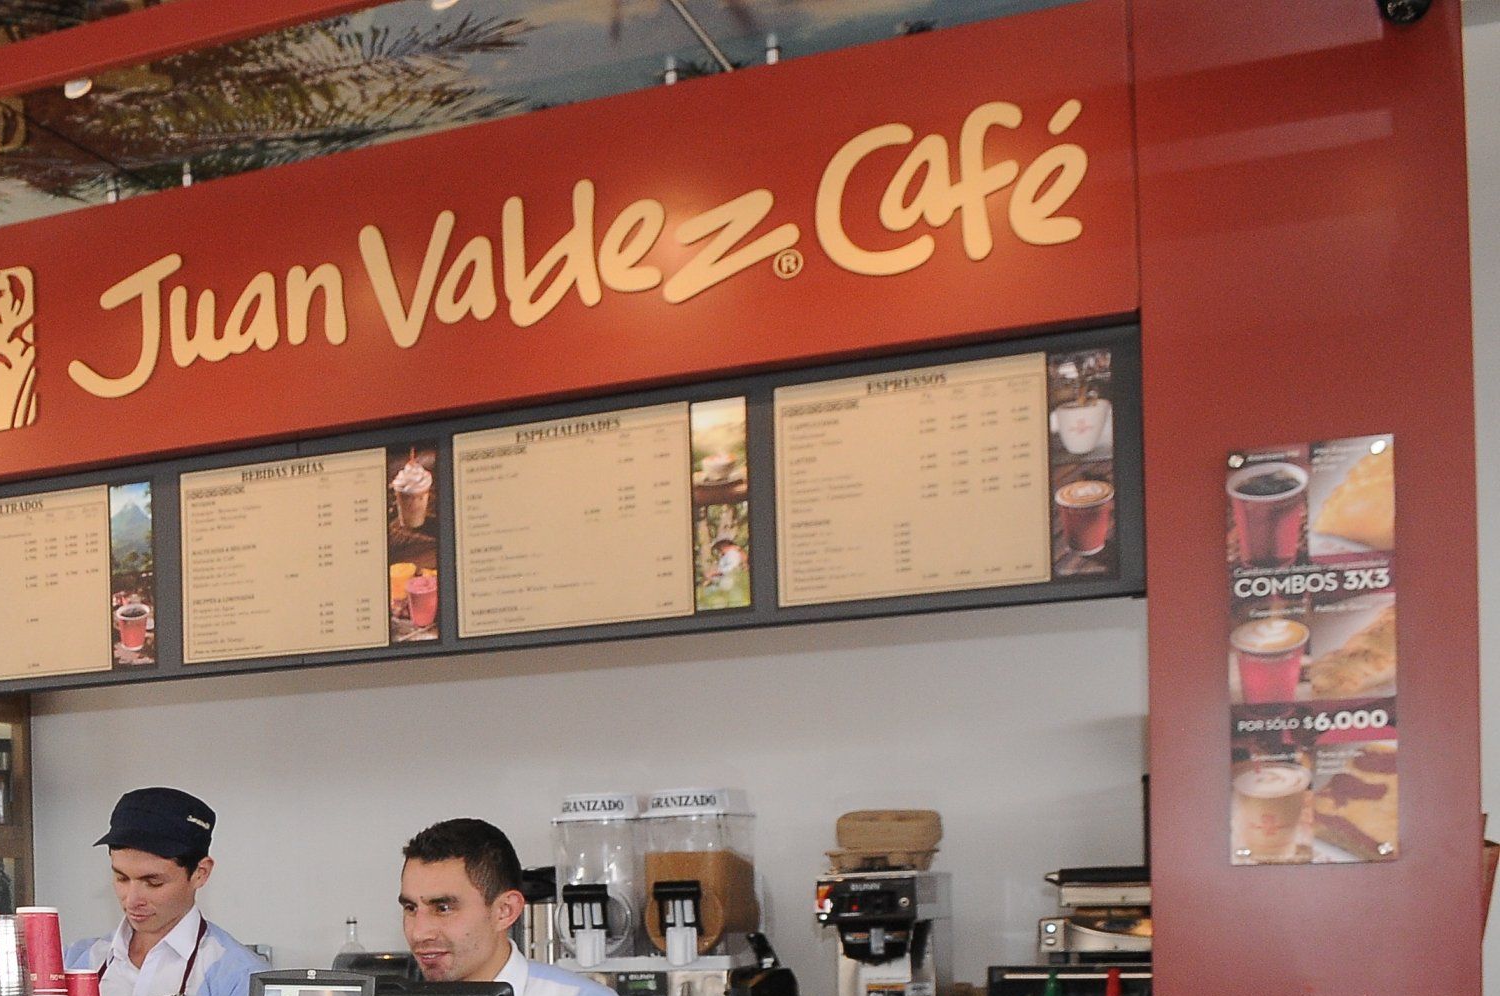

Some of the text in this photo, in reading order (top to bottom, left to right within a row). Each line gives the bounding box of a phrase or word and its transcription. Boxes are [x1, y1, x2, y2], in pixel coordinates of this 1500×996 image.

[68, 252, 347, 398] Juan
[358, 178, 801, 348] Valdez
[815, 98, 1088, 276] Café
[866, 373, 947, 395] ESPRESSOS
[516, 417, 621, 443] ESPECIALIDADES
[241, 467, 287, 482] BEBIDAS
[1234, 567, 1391, 598] COMBOS 3X3
[1237, 719, 1264, 732] POR
[561, 798, 625, 814] GRANIZADO
[651, 794, 717, 809] GRANIZADO
